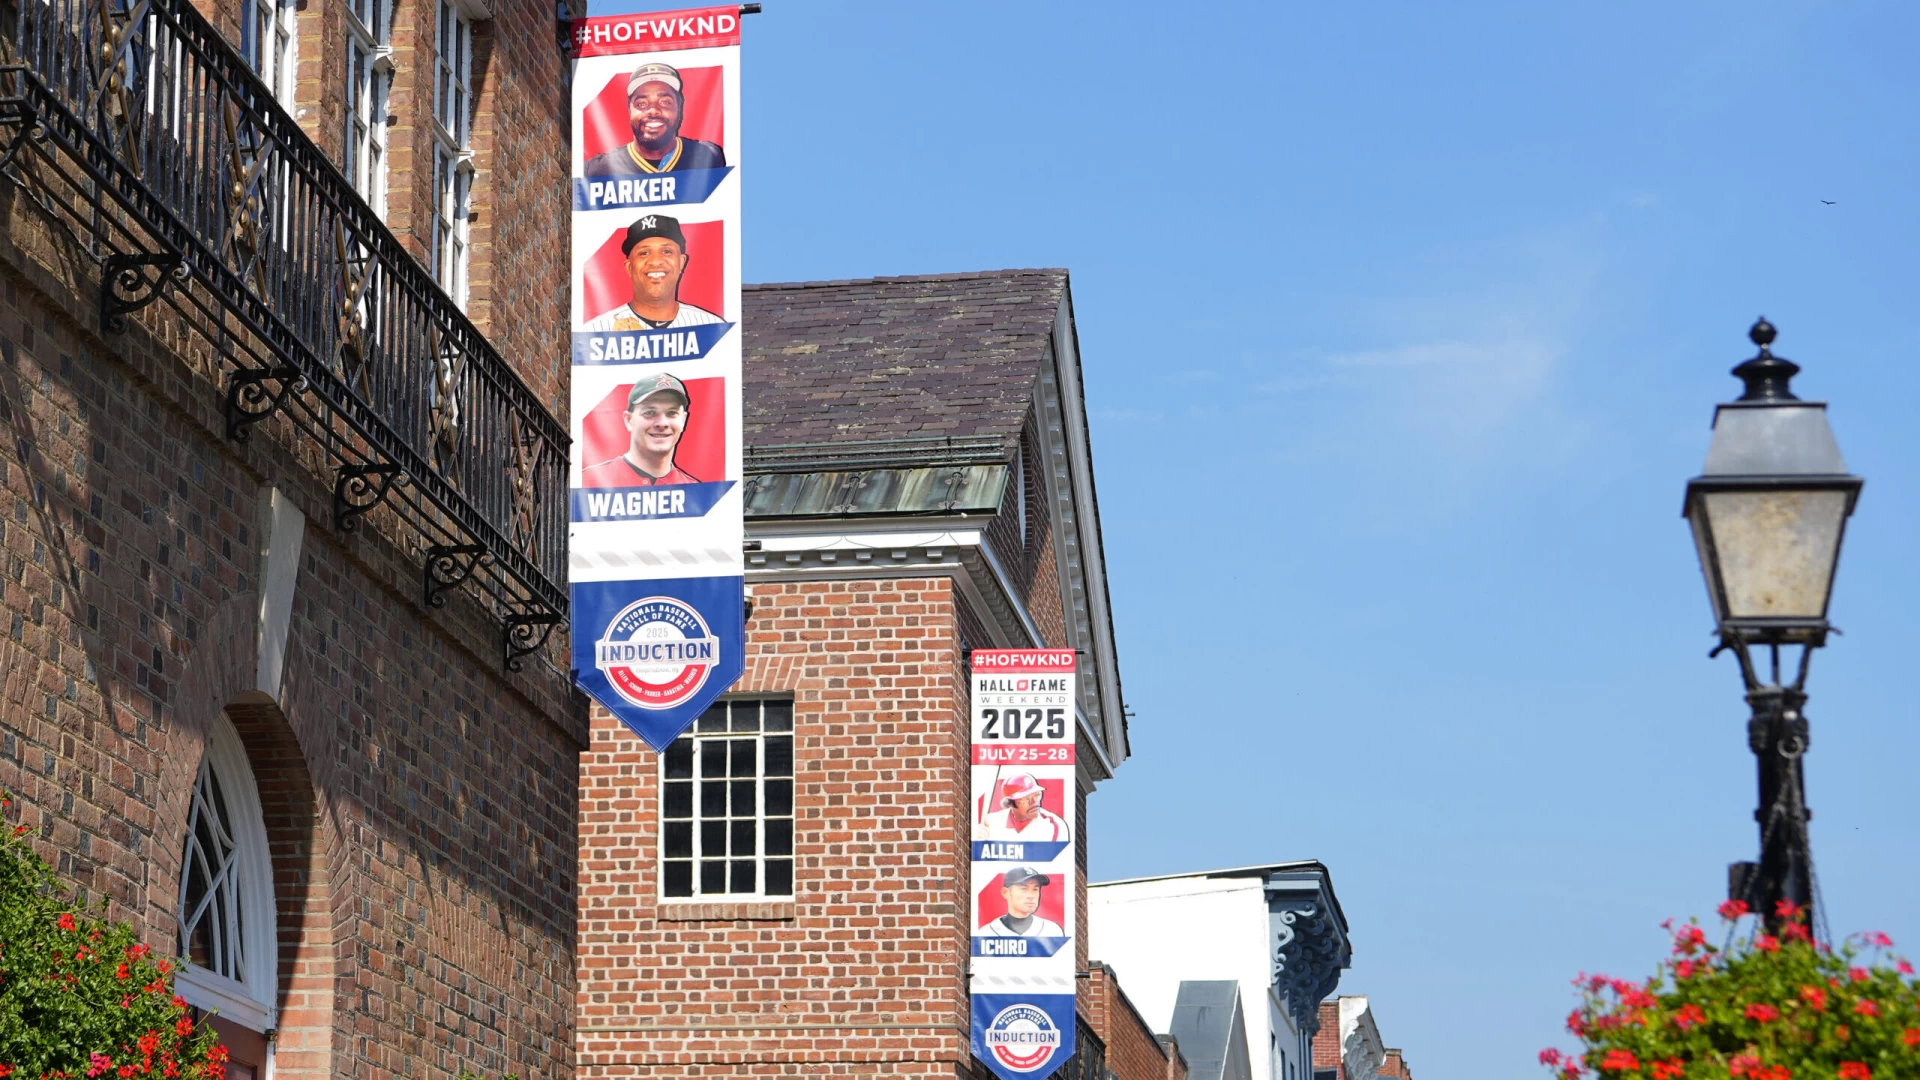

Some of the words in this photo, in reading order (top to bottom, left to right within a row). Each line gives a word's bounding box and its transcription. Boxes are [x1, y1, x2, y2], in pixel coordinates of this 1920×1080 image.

[576, 15, 736, 44] #HOFWKND
[589, 177, 676, 206] PARKER
[589, 331, 700, 361] SABATHIA
[588, 489, 686, 517] WAGNER
[616, 605, 656, 633] NATIONAL
[659, 604, 698, 631] BASEBALL
[627, 615, 649, 632] HALL
[666, 613, 687, 630] FAME
[646, 627, 669, 638] 2025
[601, 642, 712, 662] INDUCTION
[974, 654, 1073, 666] #HOFWKND
[980, 679, 1014, 691] HALL
[1031, 679, 1066, 691] FAME
[981, 696, 1066, 704] WEEKEND
[981, 708, 1065, 739] 2025
[978, 748, 1016, 760] JULY
[980, 844, 1024, 860] ALLEN
[980, 939, 1028, 955] ICHIRO
[989, 1032, 1056, 1043] INDUCTION
